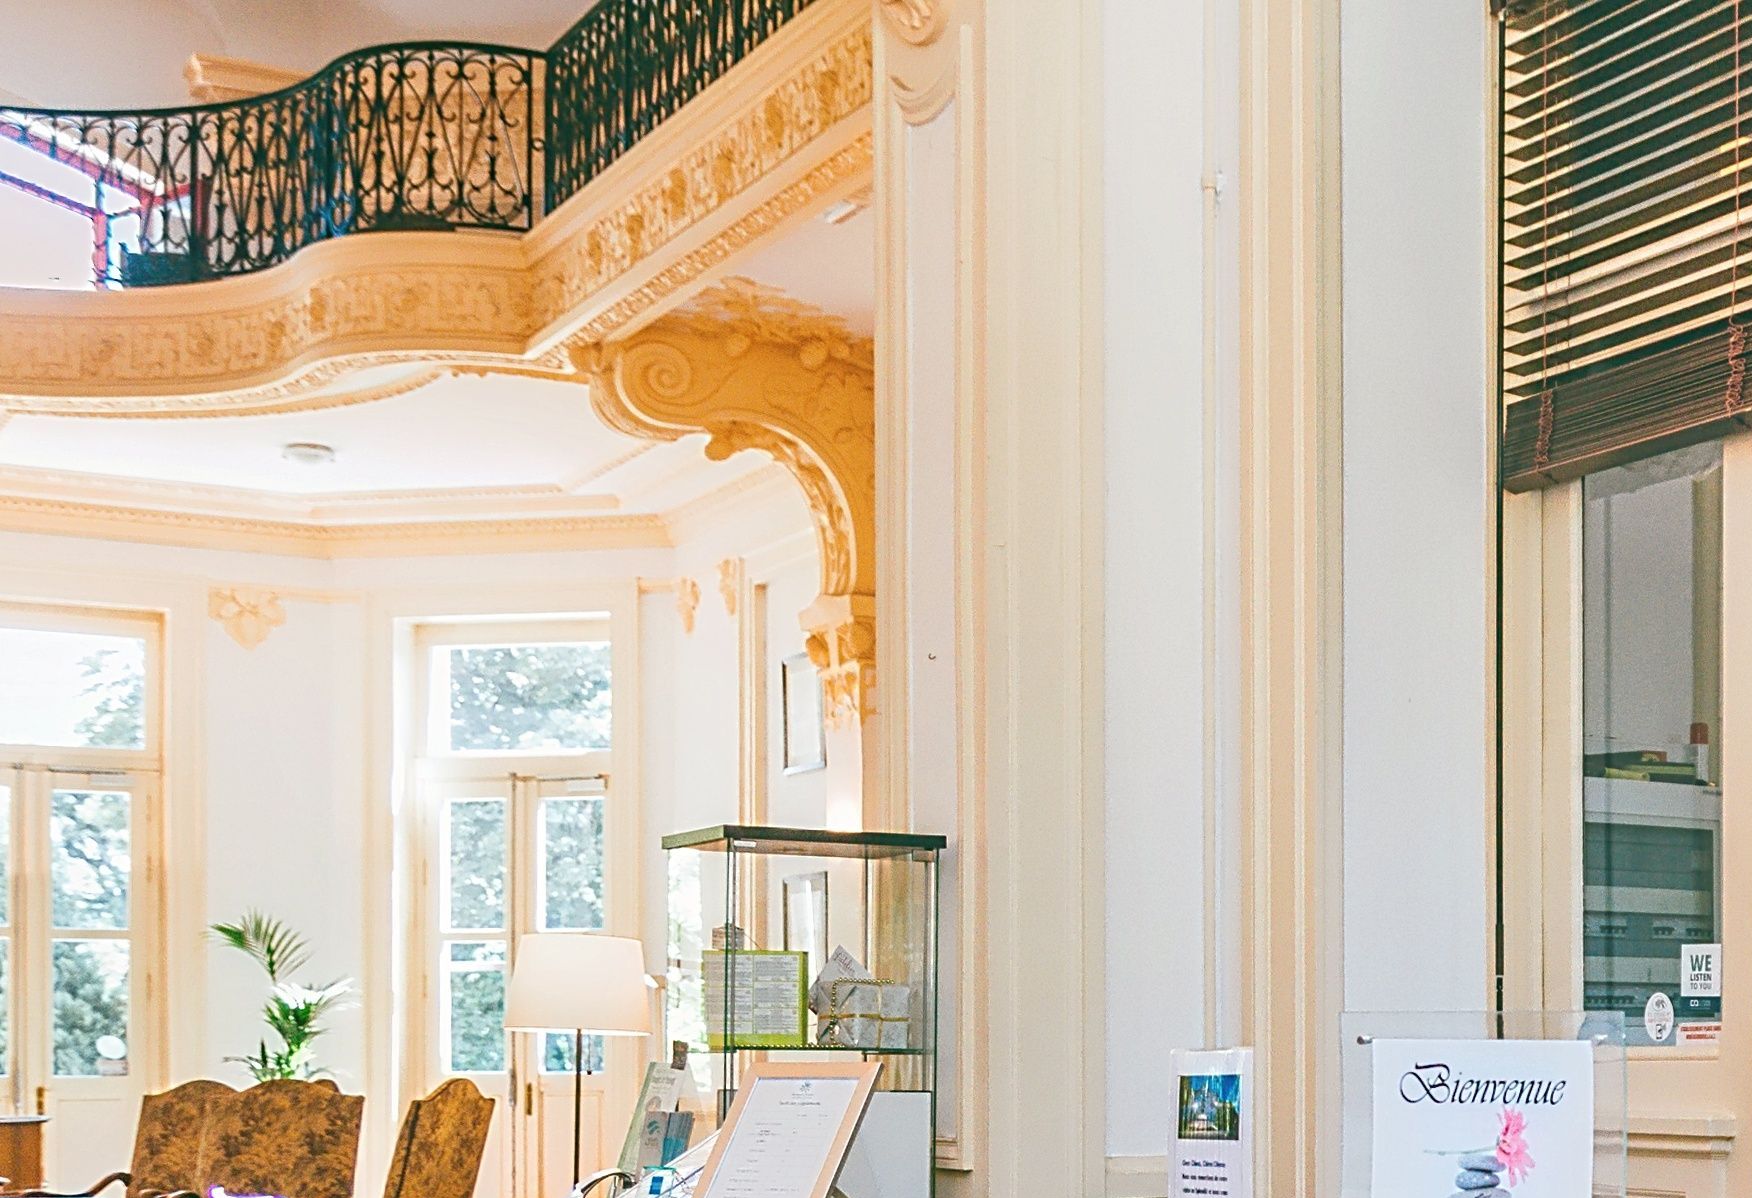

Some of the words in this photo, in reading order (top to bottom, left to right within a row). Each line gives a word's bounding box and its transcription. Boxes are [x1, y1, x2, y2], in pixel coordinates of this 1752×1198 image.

[1690, 954, 1712, 972] WE
[1690, 973, 1712, 982] LISTEN
[1400, 1062, 1566, 1106] Bienvenue
